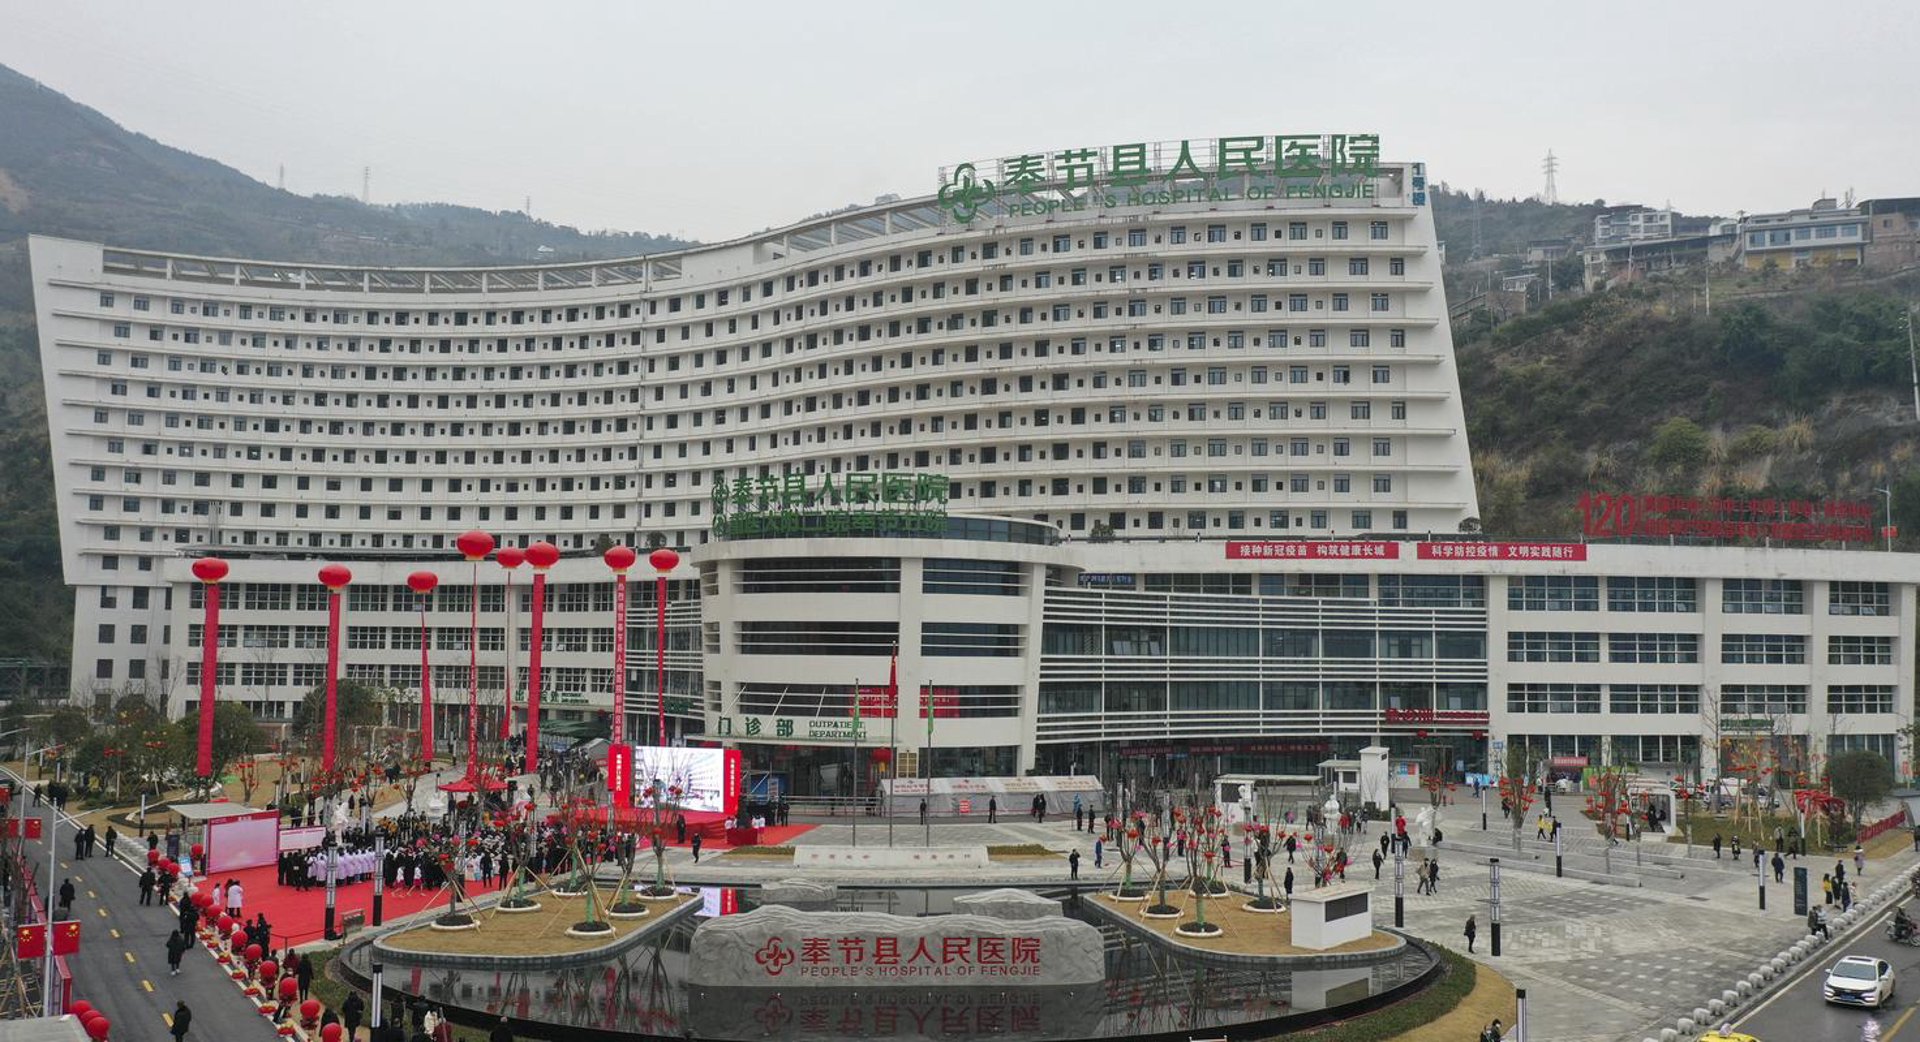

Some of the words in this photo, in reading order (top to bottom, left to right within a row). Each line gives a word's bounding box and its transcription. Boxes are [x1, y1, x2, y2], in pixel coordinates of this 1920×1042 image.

[1002, 133, 1380, 196] 奉节县人民医院
[1009, 195, 1117, 217] PEOPLE'S
[1127, 187, 1230, 207] HOSPITAL
[1246, 184, 1275, 200] OF
[1286, 184, 1374, 199] FENGJIE
[730, 472, 949, 505] 奉节县人民医院
[1574, 491, 1634, 537] 120
[1240, 544, 1307, 557] 接种新冠疫苗
[1317, 544, 1385, 557] 构筑健康长城
[1431, 545, 1499, 558] 科学防控疫情
[1508, 545, 1574, 558] 文明实践随行
[718, 716, 794, 737] 门诊部
[809, 720, 865, 729] OUTPATIET
[801, 937, 1040, 964] 奉节县人民医院
[801, 965, 874, 977] PEOPLE'S
[879, 965, 951, 976] HOSPITAL
[957, 965, 976, 976] OF
[981, 965, 1040, 976] FENGJIE
